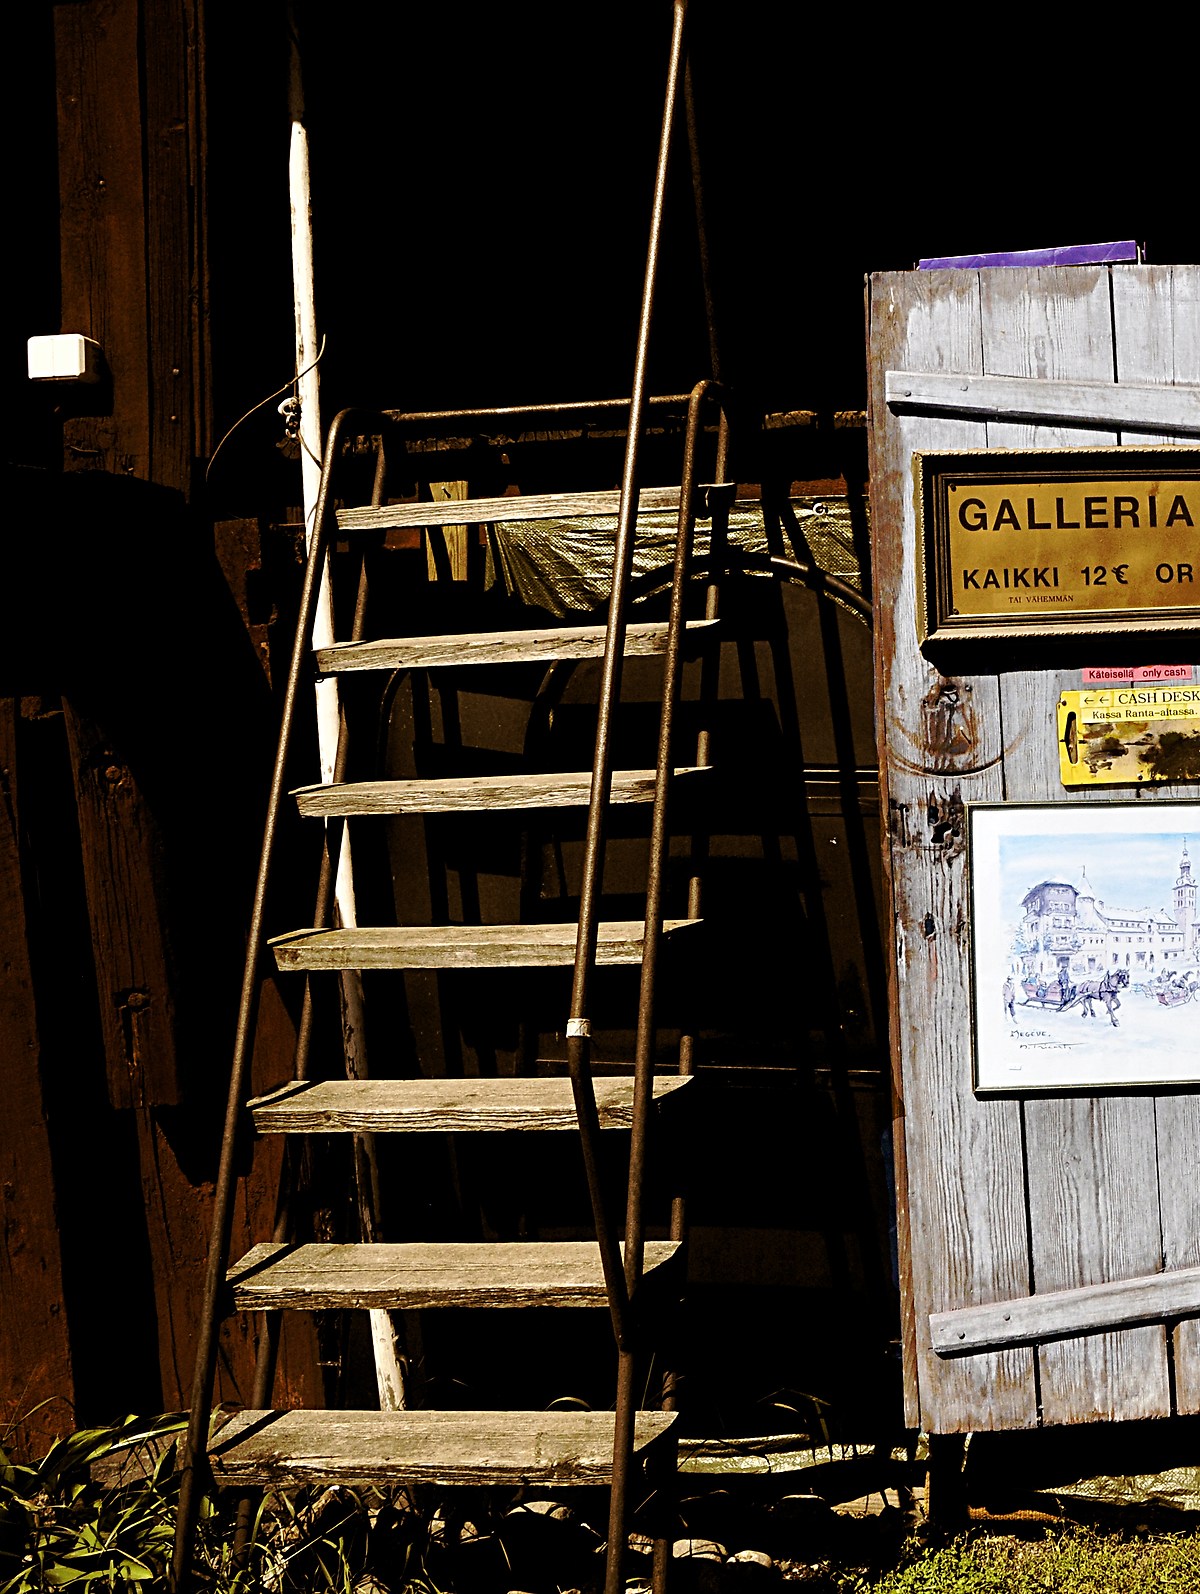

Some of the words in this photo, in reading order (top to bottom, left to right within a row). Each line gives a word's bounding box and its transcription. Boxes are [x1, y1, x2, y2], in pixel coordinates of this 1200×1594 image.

[957, 494, 1195, 532] GALLERIA
[962, 566, 1059, 590] KAIKKI
[1080, 563, 1130, 586] 12€
[1155, 562, 1193, 583] OR
[1008, 596, 1022, 604] TAI
[1026, 594, 1074, 603] VÄHEMMÄN
[1088, 670, 1134, 679] Käteisellä
[1142, 668, 1162, 679] only
[1164, 667, 1187, 677] cash
[1118, 693, 1157, 705] CASH
[1162, 690, 1200, 703] DESK
[1092, 710, 1122, 720] Kassa
